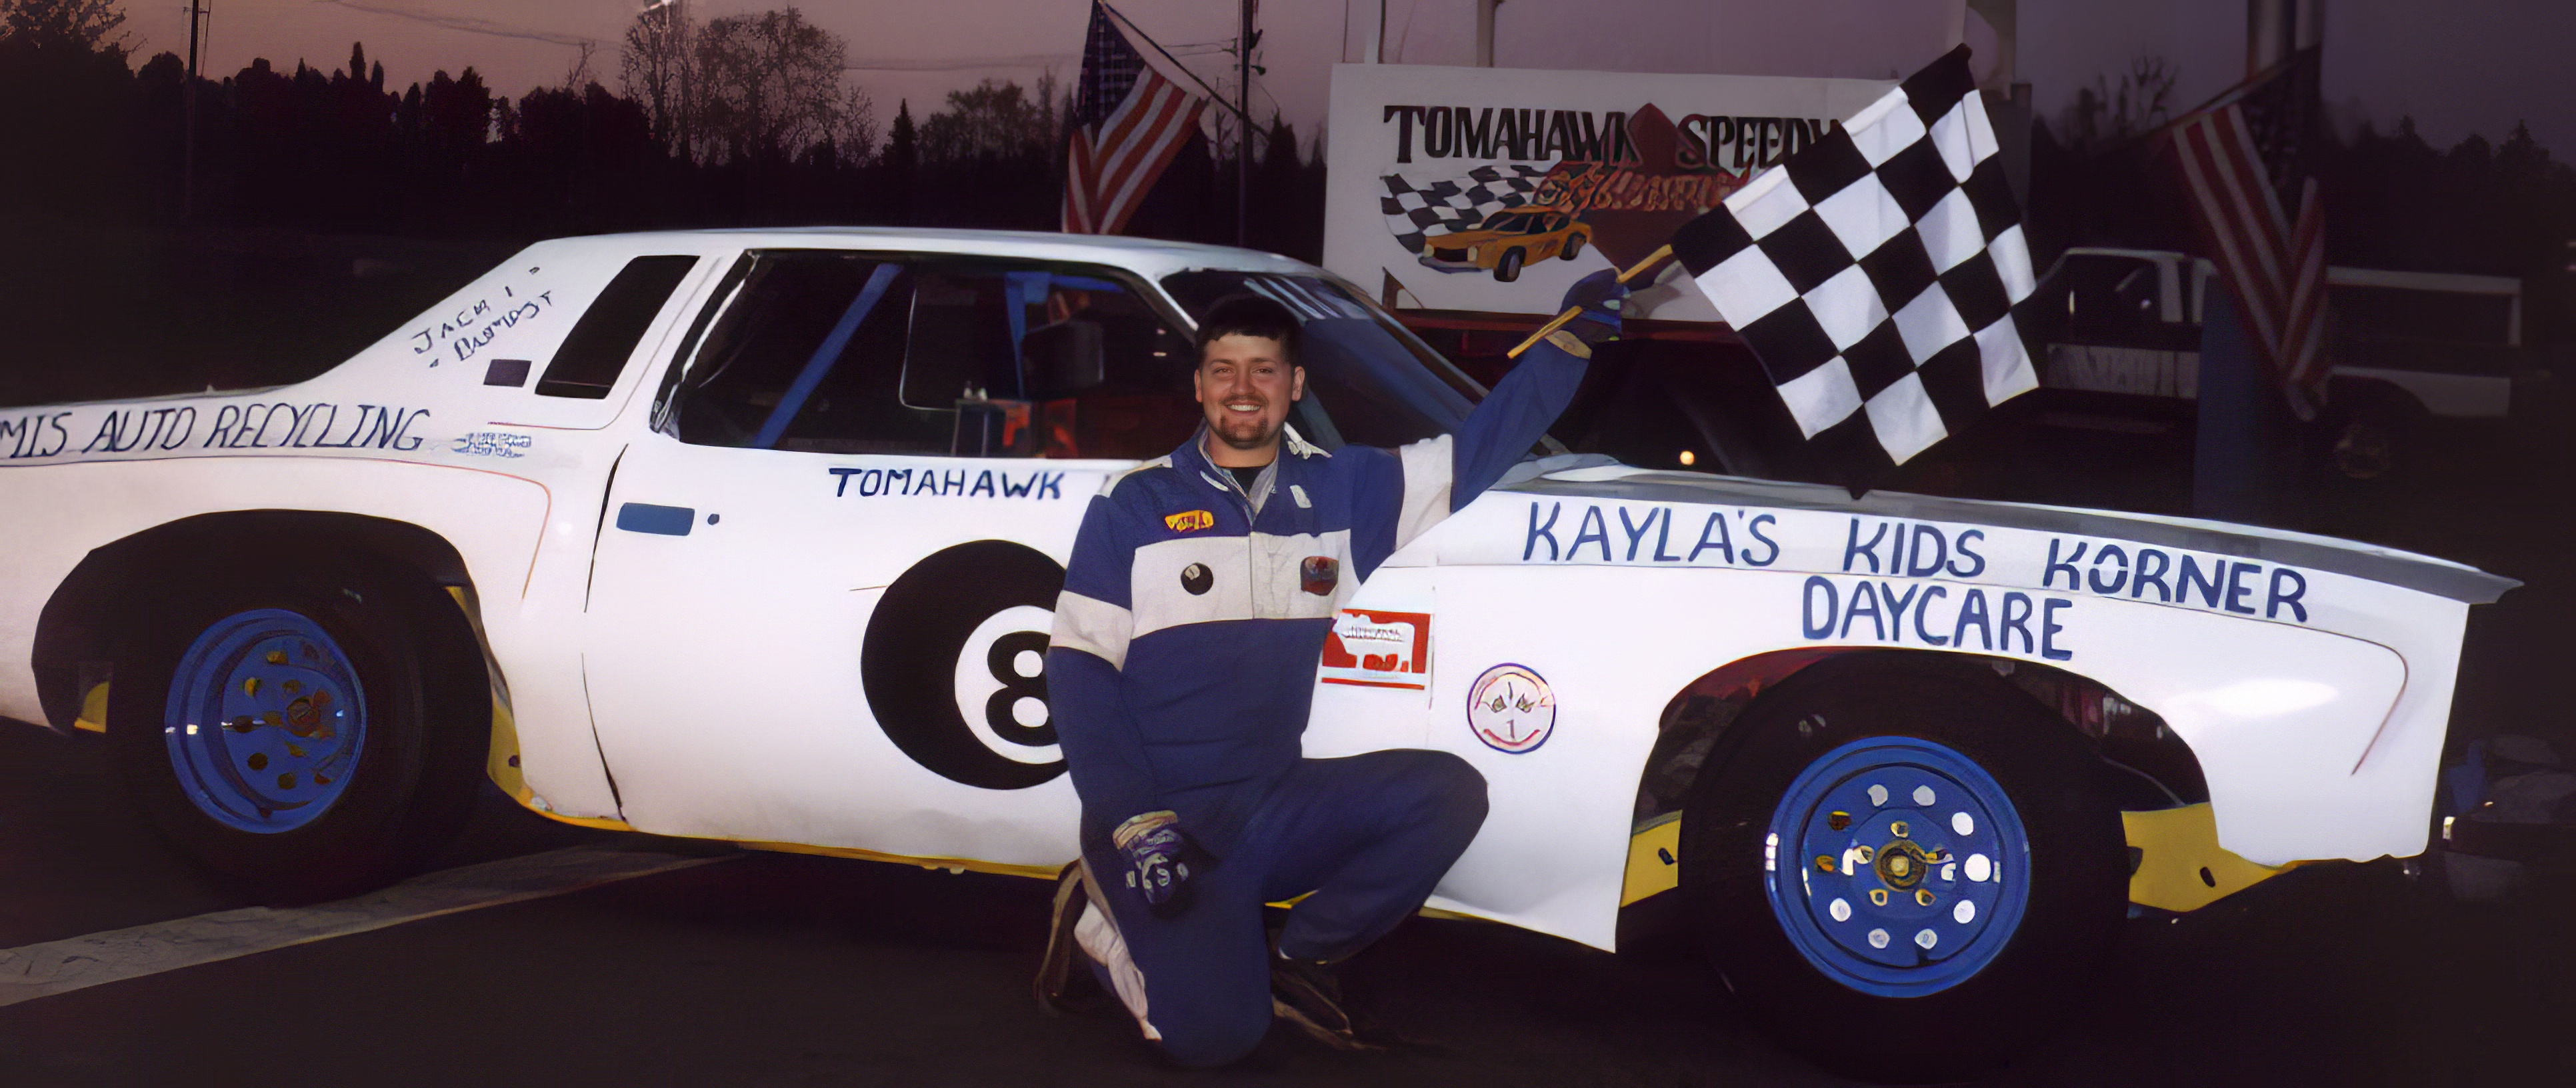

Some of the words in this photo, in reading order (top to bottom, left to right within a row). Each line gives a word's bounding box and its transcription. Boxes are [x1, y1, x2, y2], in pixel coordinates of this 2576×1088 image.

[1383, 105, 1644, 166] TOMAHAWK
[81, 406, 197, 454] AUTO
[202, 402, 431, 451] RECYCLING
[828, 467, 1065, 500] TOMAHAWK
[1522, 501, 1780, 567] KAYLA'S
[1842, 517, 1986, 579] KIDS
[2042, 537, 2308, 623] KORNER
[1802, 575, 2073, 661] DAYCARE
[985, 630, 1060, 747] 8
